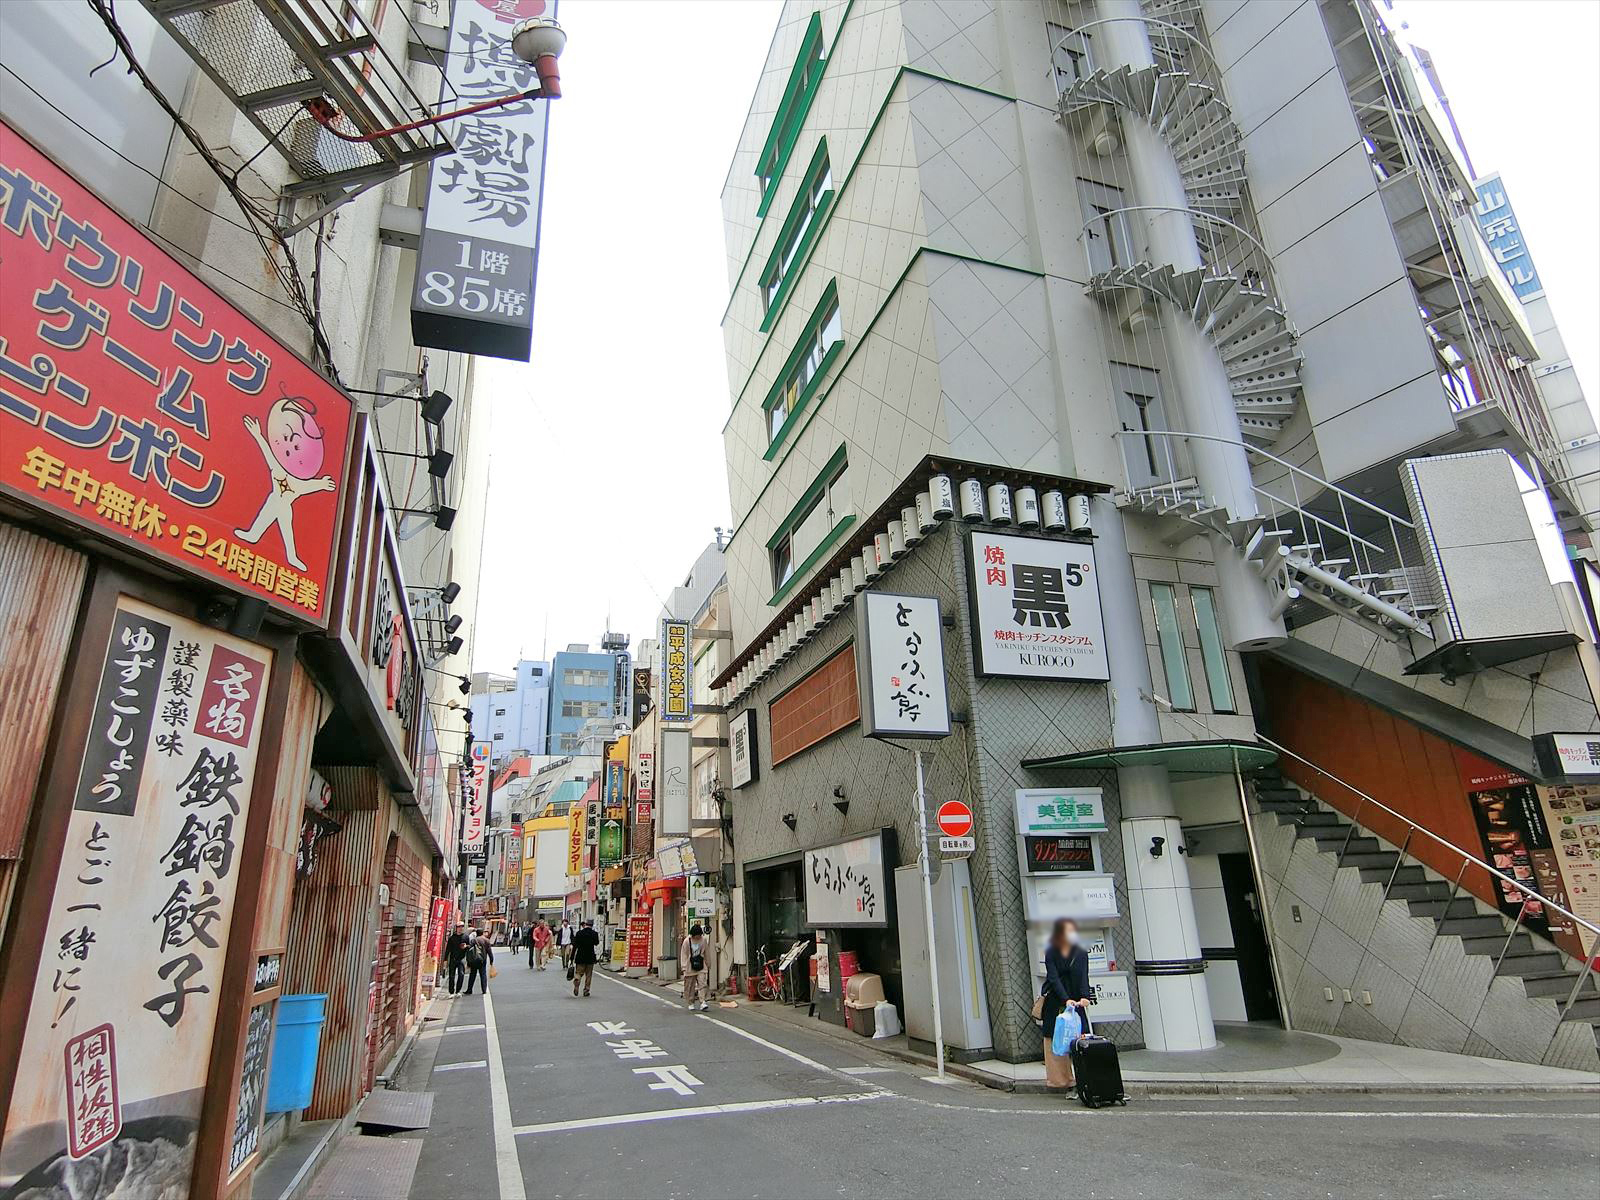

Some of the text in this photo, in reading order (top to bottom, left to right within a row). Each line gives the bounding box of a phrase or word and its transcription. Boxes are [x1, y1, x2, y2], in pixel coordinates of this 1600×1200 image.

[438, 20, 540, 229] 博多劇場
[454, 240, 510, 276] 1階
[1478, 191, 1534, 287] 山京ビル
[0, 164, 272, 396] ボウリング
[420, 270, 528, 318] 85席
[33, 278, 211, 442] ゲーム
[0, 337, 226, 509] ピンポン
[940, 478, 951, 507] タン塩
[20, 446, 322, 612] 年中無休・24時間営業
[984, 544, 1007, 588] 焼肉
[1011, 563, 1072, 630] 黒
[890, 602, 931, 723] とらふぐ亭
[993, 629, 1094, 647] 焼肉キッチンスタジアム
[994, 642, 1095, 655] YAKINIKU KITCHEN STADIUM
[1019, 653, 1075, 668] KUROGO
[91, 625, 157, 804] ゆずこしょう
[154, 639, 202, 758] 謹製薬味
[204, 662, 255, 740] 名物
[665, 766, 687, 785] R
[571, 810, 582, 872] ゲームセンター
[942, 839, 972, 849] 自転車を除く
[1037, 803, 1094, 818] 美容室
[462, 844, 483, 852] SLOT
[142, 746, 244, 1028] 鉄鍋餃子
[812, 853, 876, 918] とらふぐ亭
[72, 1032, 116, 1147] 相性抜群
[585, 1020, 705, 1096] 止まれ
